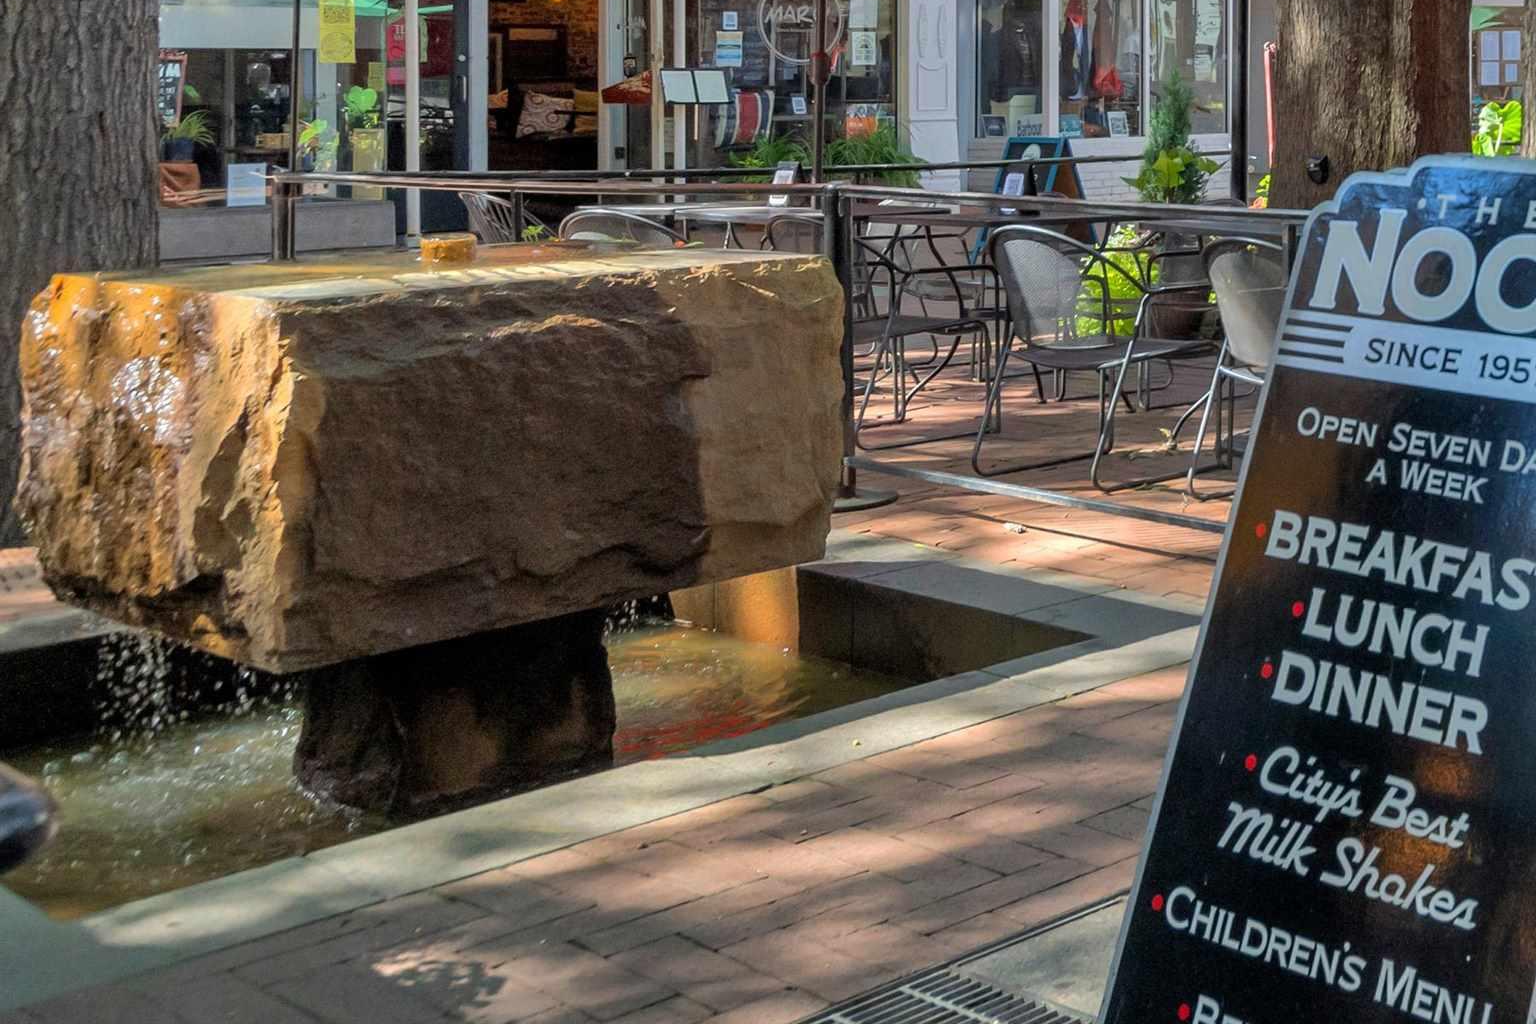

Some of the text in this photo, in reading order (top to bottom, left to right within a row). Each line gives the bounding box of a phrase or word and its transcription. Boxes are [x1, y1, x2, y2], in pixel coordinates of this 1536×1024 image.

[764, 4, 817, 24] MAR
[1364, 338, 1463, 375] SINCE
[1297, 406, 1378, 448] OPEN
[1387, 422, 1492, 468] SEVEN
[1365, 458, 1488, 505] A WEEK
[1301, 586, 1490, 678] LUNCH
[1271, 649, 1489, 755] DINNER
[1259, 745, 1471, 849] City's Best
[1216, 801, 1480, 931] Milk Shakes
[1165, 885, 1494, 1024] CHILDREN'S MENU
